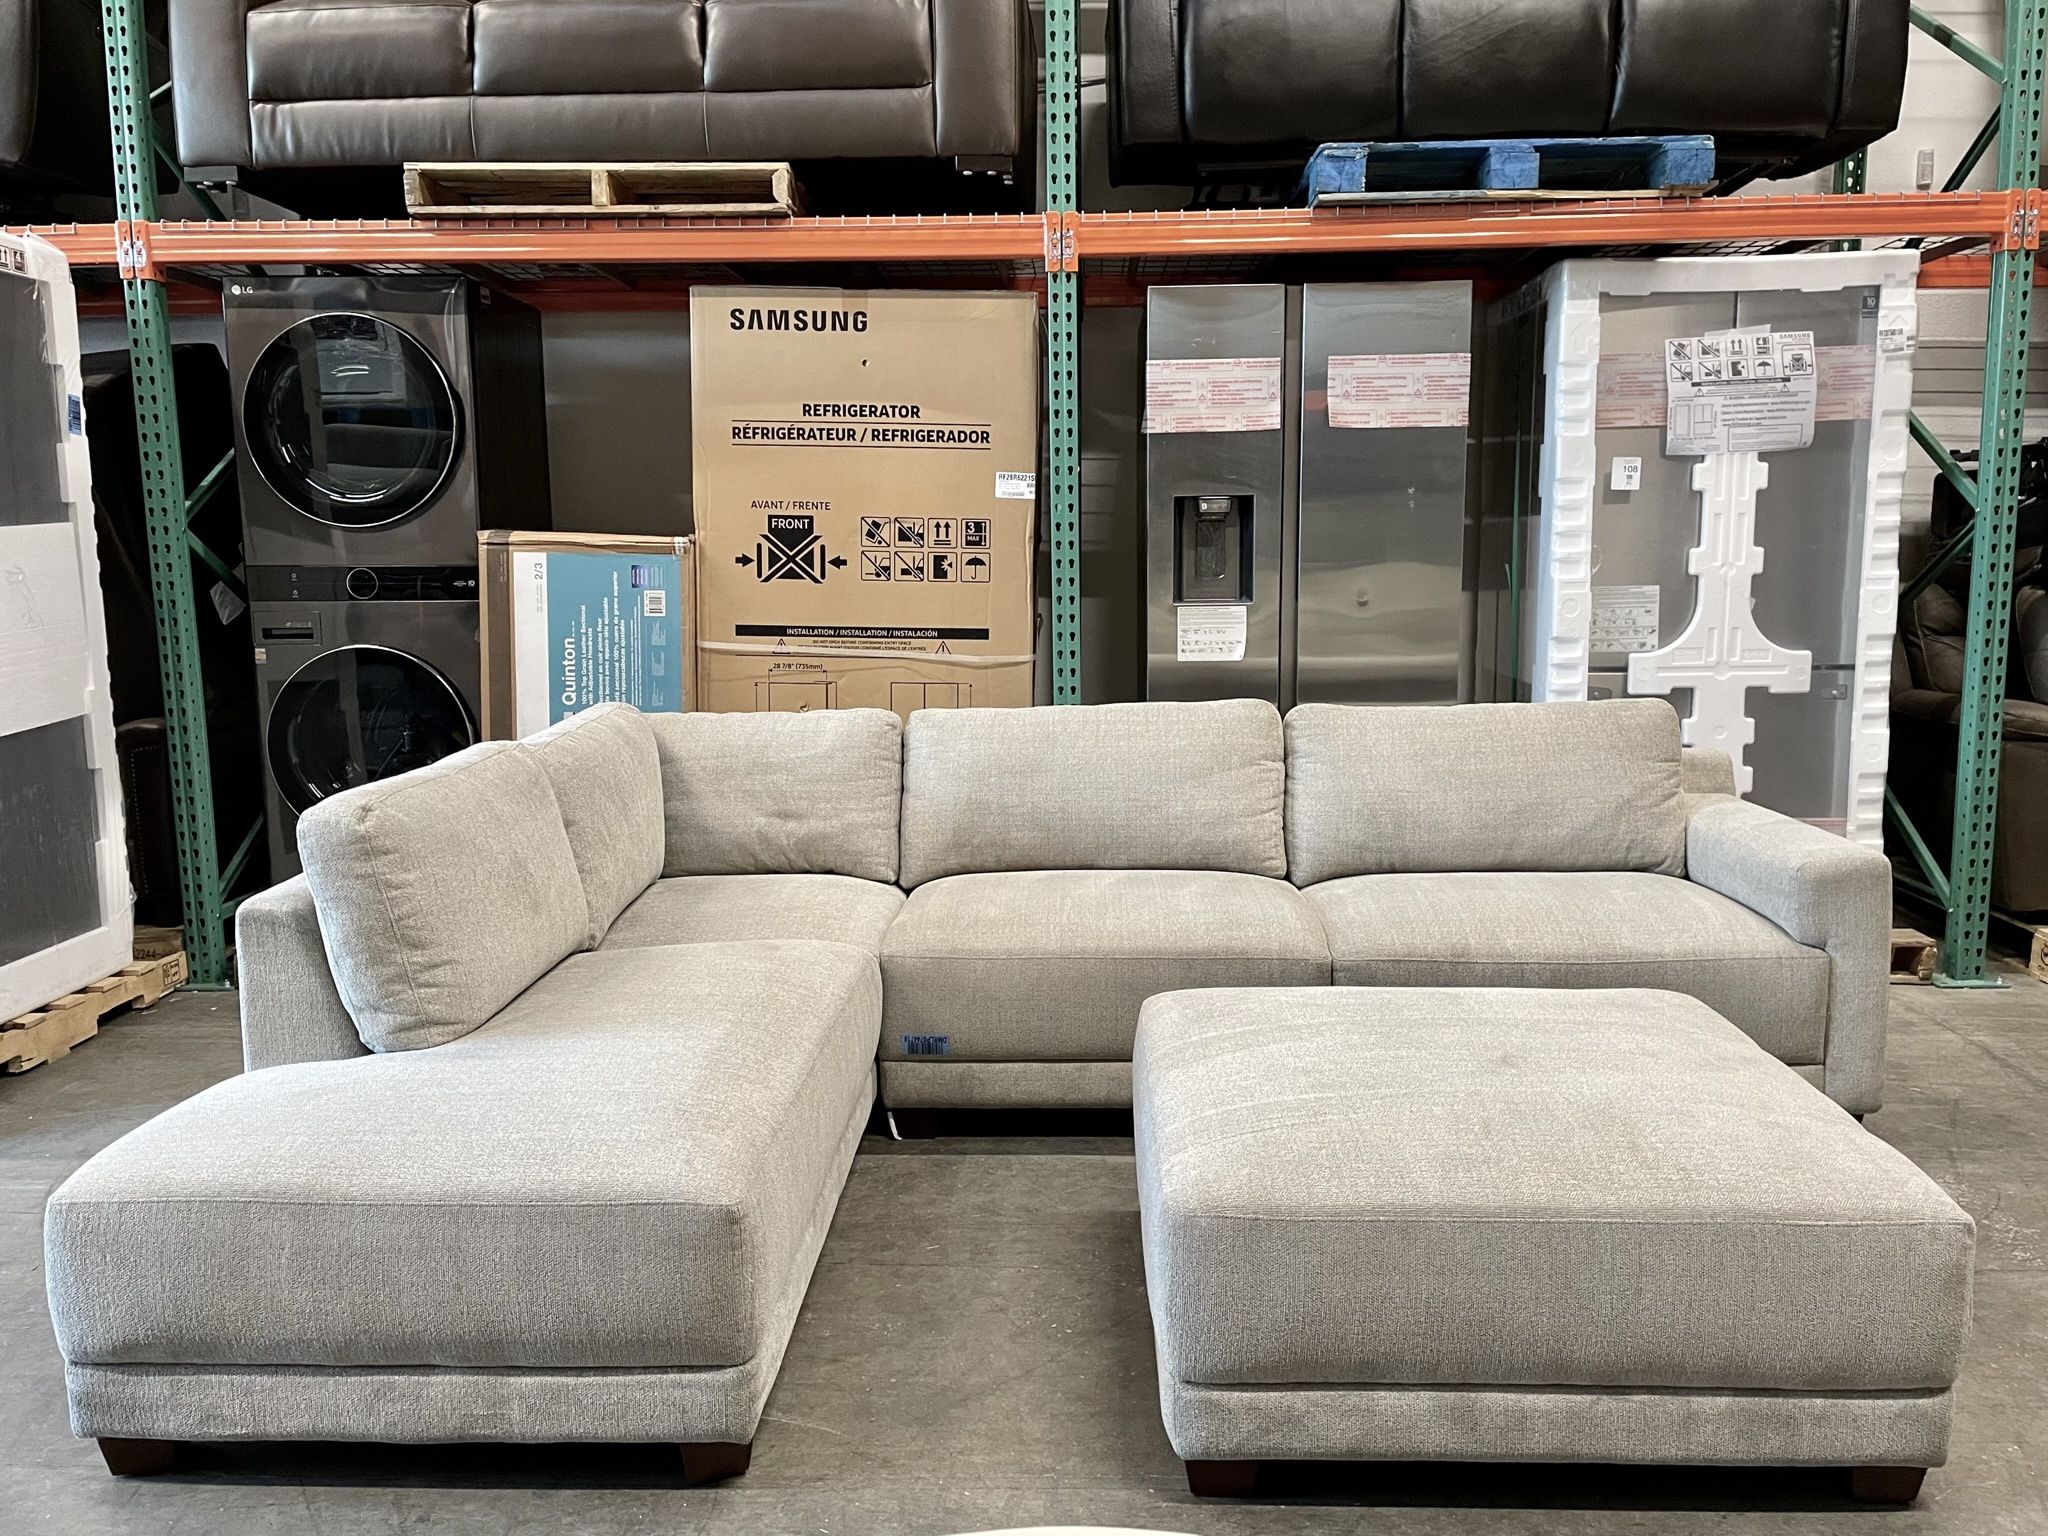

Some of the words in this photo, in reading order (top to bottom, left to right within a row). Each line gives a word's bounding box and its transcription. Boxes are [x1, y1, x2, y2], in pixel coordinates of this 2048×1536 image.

[241, 286, 253, 294] LG
[730, 308, 867, 332] SAMSUNG
[802, 403, 921, 418] REFRIGERATOR
[732, 423, 857, 442] RÉFRIGÉRATEUR
[871, 429, 990, 444] REFRIGERADOR
[1623, 465, 1639, 473] 108
[751, 500, 784, 510] AVANT
[792, 501, 831, 510] FRENTE
[771, 518, 810, 529] FRONT
[967, 522, 975, 533] 3
[534, 563, 543, 580] 2/3
[893, 629, 938, 638] INSTALACIÓN
[561, 638, 576, 706] Quinton
